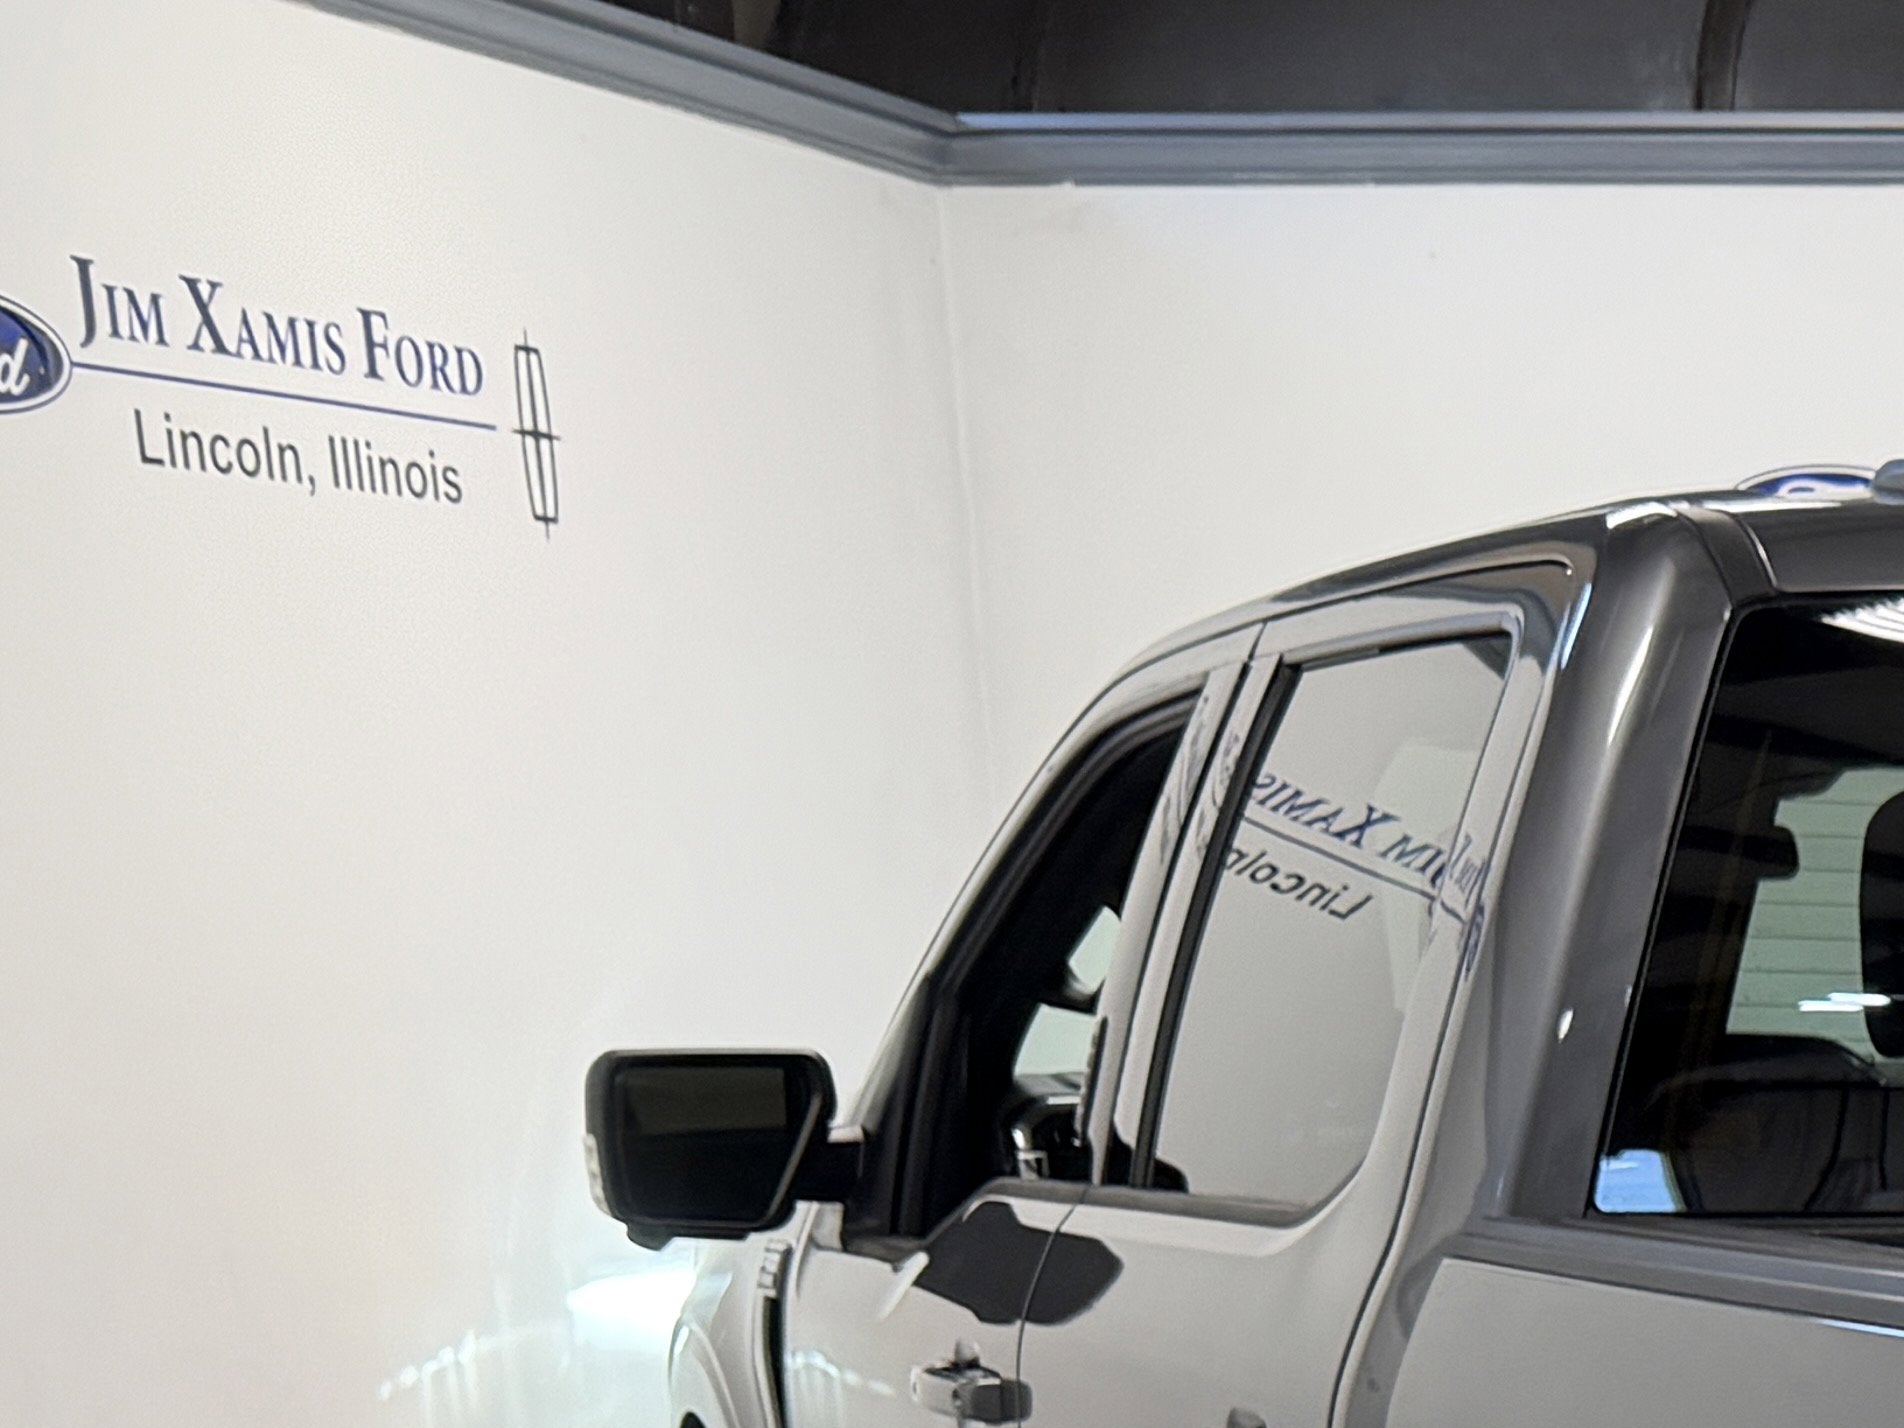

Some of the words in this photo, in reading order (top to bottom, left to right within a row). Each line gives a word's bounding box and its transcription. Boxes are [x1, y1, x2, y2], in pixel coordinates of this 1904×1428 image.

[69, 254, 170, 349] JIM
[179, 273, 347, 376] XAMIS
[356, 307, 484, 396] FORD
[134, 407, 317, 497] Lincoln,
[328, 433, 464, 504] Illinois
